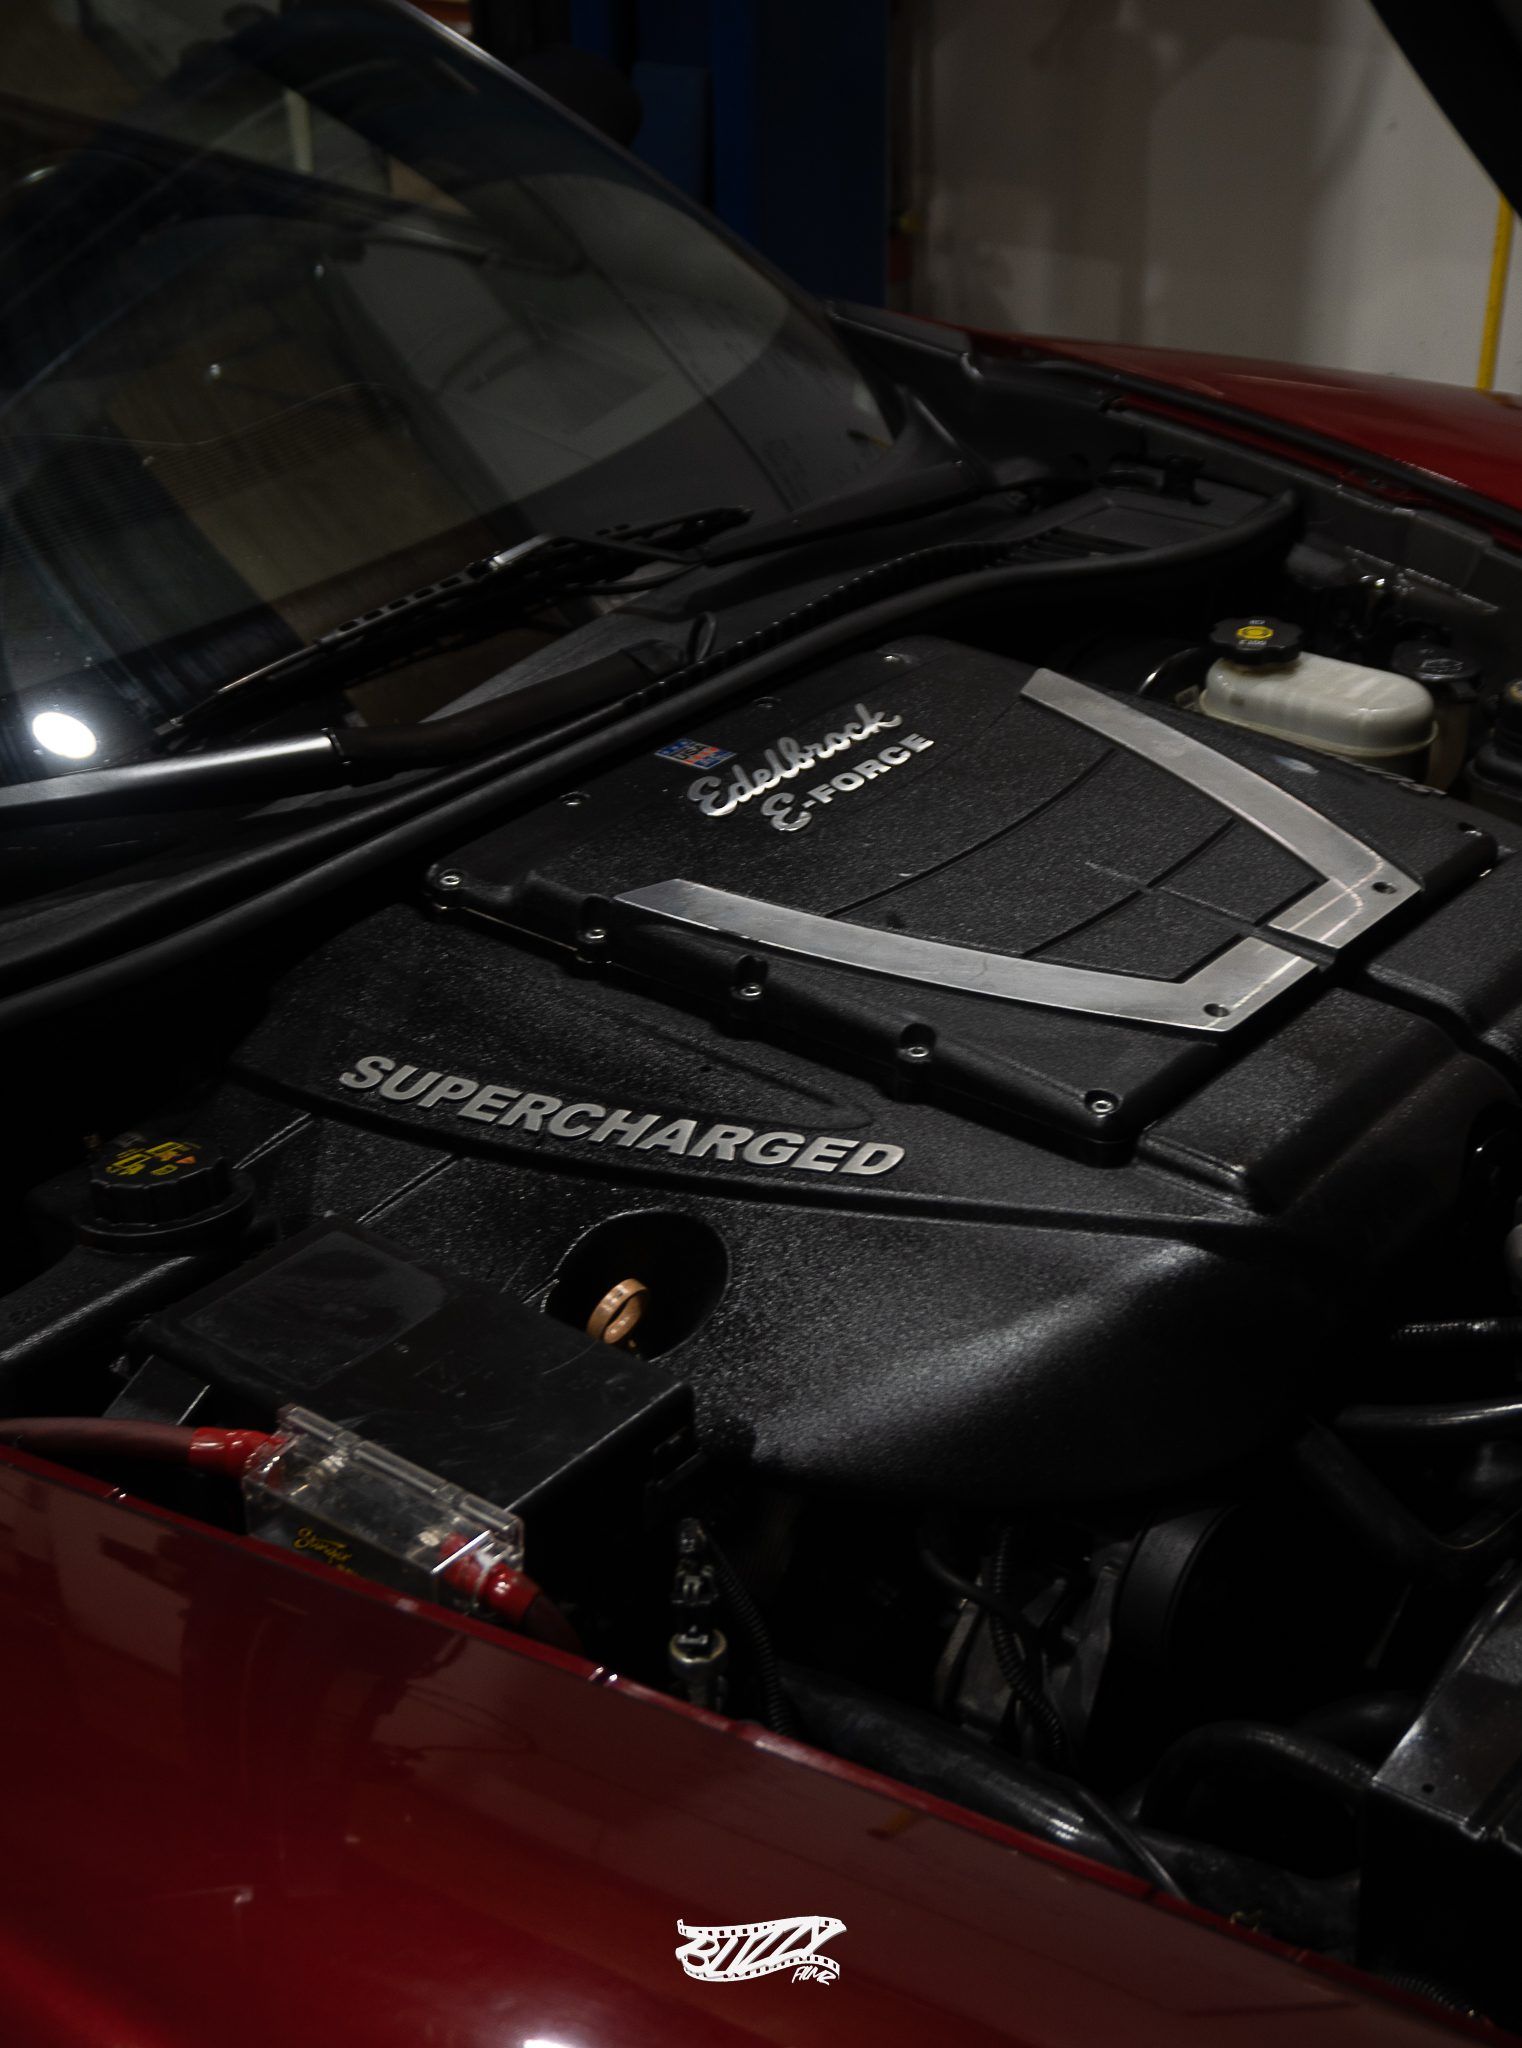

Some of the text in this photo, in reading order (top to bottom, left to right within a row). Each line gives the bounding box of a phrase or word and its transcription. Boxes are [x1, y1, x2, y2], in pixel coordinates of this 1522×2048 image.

[687, 703, 904, 817] Edelbrock
[760, 733, 935, 831] E-FORCE
[338, 1055, 906, 1177] SUPERCHARGED
